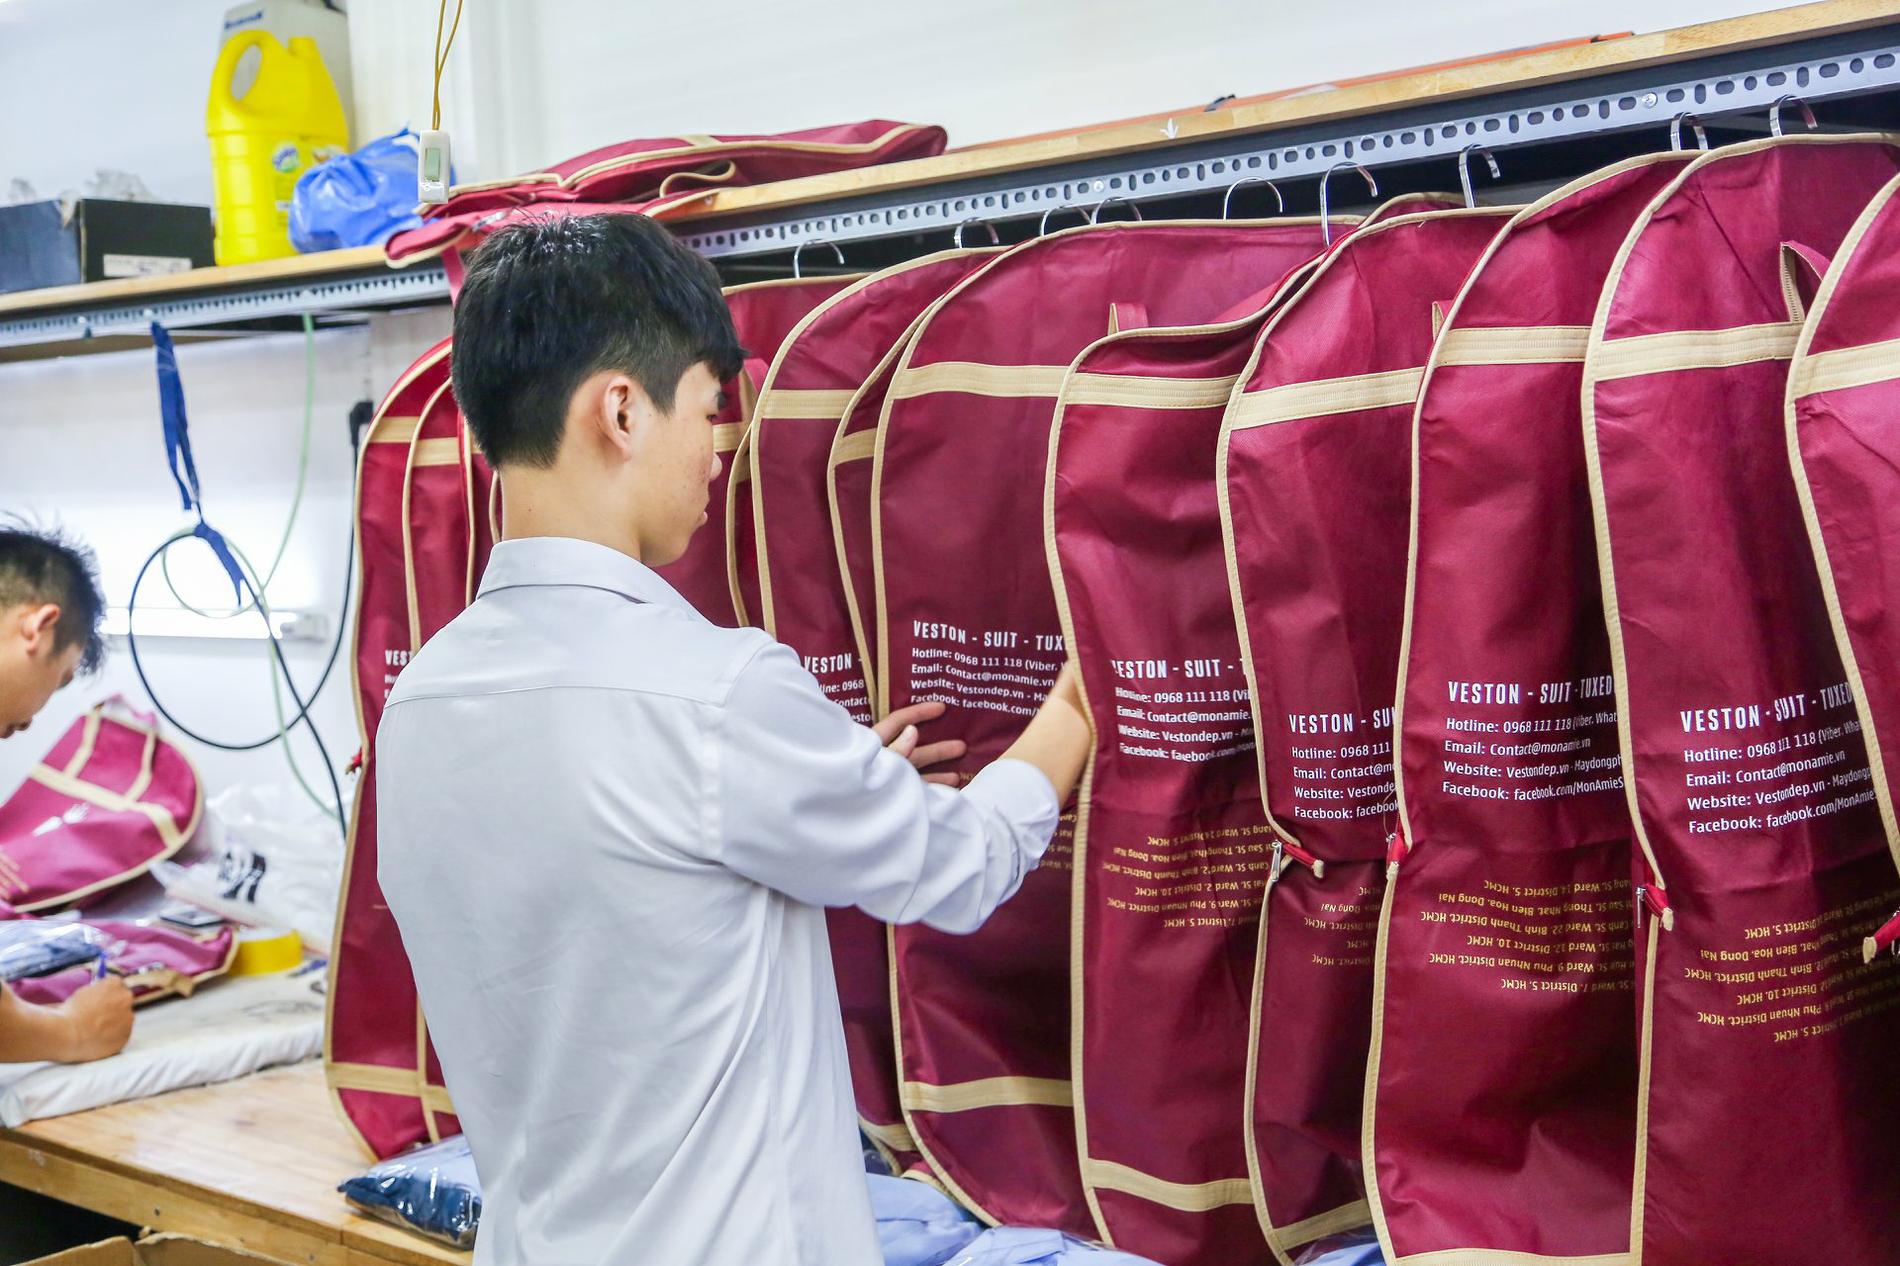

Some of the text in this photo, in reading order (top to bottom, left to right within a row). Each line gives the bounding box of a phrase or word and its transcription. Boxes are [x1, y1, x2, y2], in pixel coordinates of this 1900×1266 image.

[913, 620, 966, 644] VESTON
[984, 631, 1018, 648] SUIT
[804, 653, 852, 673] VESTON
[912, 648, 952, 658] Hotline:
[954, 652, 978, 665] 0968
[982, 657, 999, 666] 111
[1004, 657, 1022, 668] 118
[911, 663, 943, 674] Email:
[1184, 659, 1220, 678] SUIT
[842, 679, 865, 691] 0968
[911, 678, 955, 689] Website:
[956, 683, 1024, 699] Vestondep.vn
[1154, 692, 1183, 703] 0968
[1186, 692, 1206, 702] 111
[1210, 691, 1230, 702] 118
[1448, 681, 1519, 704] VESTON
[1540, 682, 1571, 704] SUIT
[1117, 706, 1145, 719] Email:
[1680, 705, 1760, 732] VESTON
[1774, 694, 1805, 721] SUIT
[1289, 714, 1353, 733] VESTON
[1446, 718, 1572, 734] Hotline: 0968 111 118
[1118, 725, 1233, 743] Website: Vestondep.vn
[1120, 743, 1169, 758] Facebook:
[1292, 742, 1390, 759] Hotline: 0968 111
[1445, 741, 1485, 755] Email:
[1684, 748, 1742, 762] Hotline:
[1747, 742, 1776, 758] 0968
[1794, 732, 1816, 748] 118
[1293, 767, 1326, 779] Email:
[1444, 761, 1569, 779] Website: Vestondep.vn
[1686, 750, 1846, 787] Email: Contact@monamie.vn
[1294, 786, 1343, 799] Website:
[1443, 781, 1509, 800] Facebook:
[1687, 780, 1825, 811] Website: Vestondep.vn
[1294, 806, 1352, 819] Facebook:
[1689, 789, 1876, 834] Facebook: facebook.com/MonAmie
[1147, 835, 1170, 847] HCMC
[1127, 848, 1149, 863] Dong
[1210, 864, 1233, 873] Ward
[1134, 887, 1158, 896] HCMC
[1174, 883, 1202, 894] District
[1215, 882, 1239, 891] Ward
[1484, 880, 1509, 894] HCMC
[1512, 887, 1521, 896] 5.
[1524, 887, 1558, 897] District
[1574, 882, 1600, 894] Ward
[1106, 897, 1126, 910] HCMC
[1190, 900, 1206, 909] Phu
[1439, 893, 1455, 903] Nai
[1458, 893, 1484, 907] Dong
[1487, 899, 1509, 912] Hoa.
[1512, 905, 1534, 916] Bien
[1163, 918, 1185, 927] HCMC
[1304, 917, 1326, 929] HCMC
[1420, 911, 1447, 923] HCMC
[1490, 918, 1521, 933] Thanh
[1524, 925, 1548, 936] Binh
[1565, 921, 1592, 933] Ward
[1783, 920, 1817, 934] District
[1744, 926, 1771, 939] HCMC
[1467, 935, 1493, 947] HCMC
[1496, 938, 1511, 949] 10.
[1514, 941, 1550, 954] District
[1568, 942, 1597, 953] Ward
[1429, 952, 1456, 965] HCMC
[1700, 944, 1797, 961] Bien Hoa. Dong Nai
[1312, 954, 1334, 966] HCMC
[1498, 958, 1531, 971] Nhuan
[1533, 962, 1553, 972] Phu
[1567, 962, 1594, 974] Ward
[1684, 963, 1812, 984] Binh Thanh District. HCMC
[1501, 979, 1527, 990] HCMC
[1541, 981, 1578, 993] District
[1737, 984, 1817, 1005] District 10. HCMC
[1697, 1004, 1821, 1026] Phu Nhuan District. HCMC
[1774, 1028, 1798, 1042] HCMC
